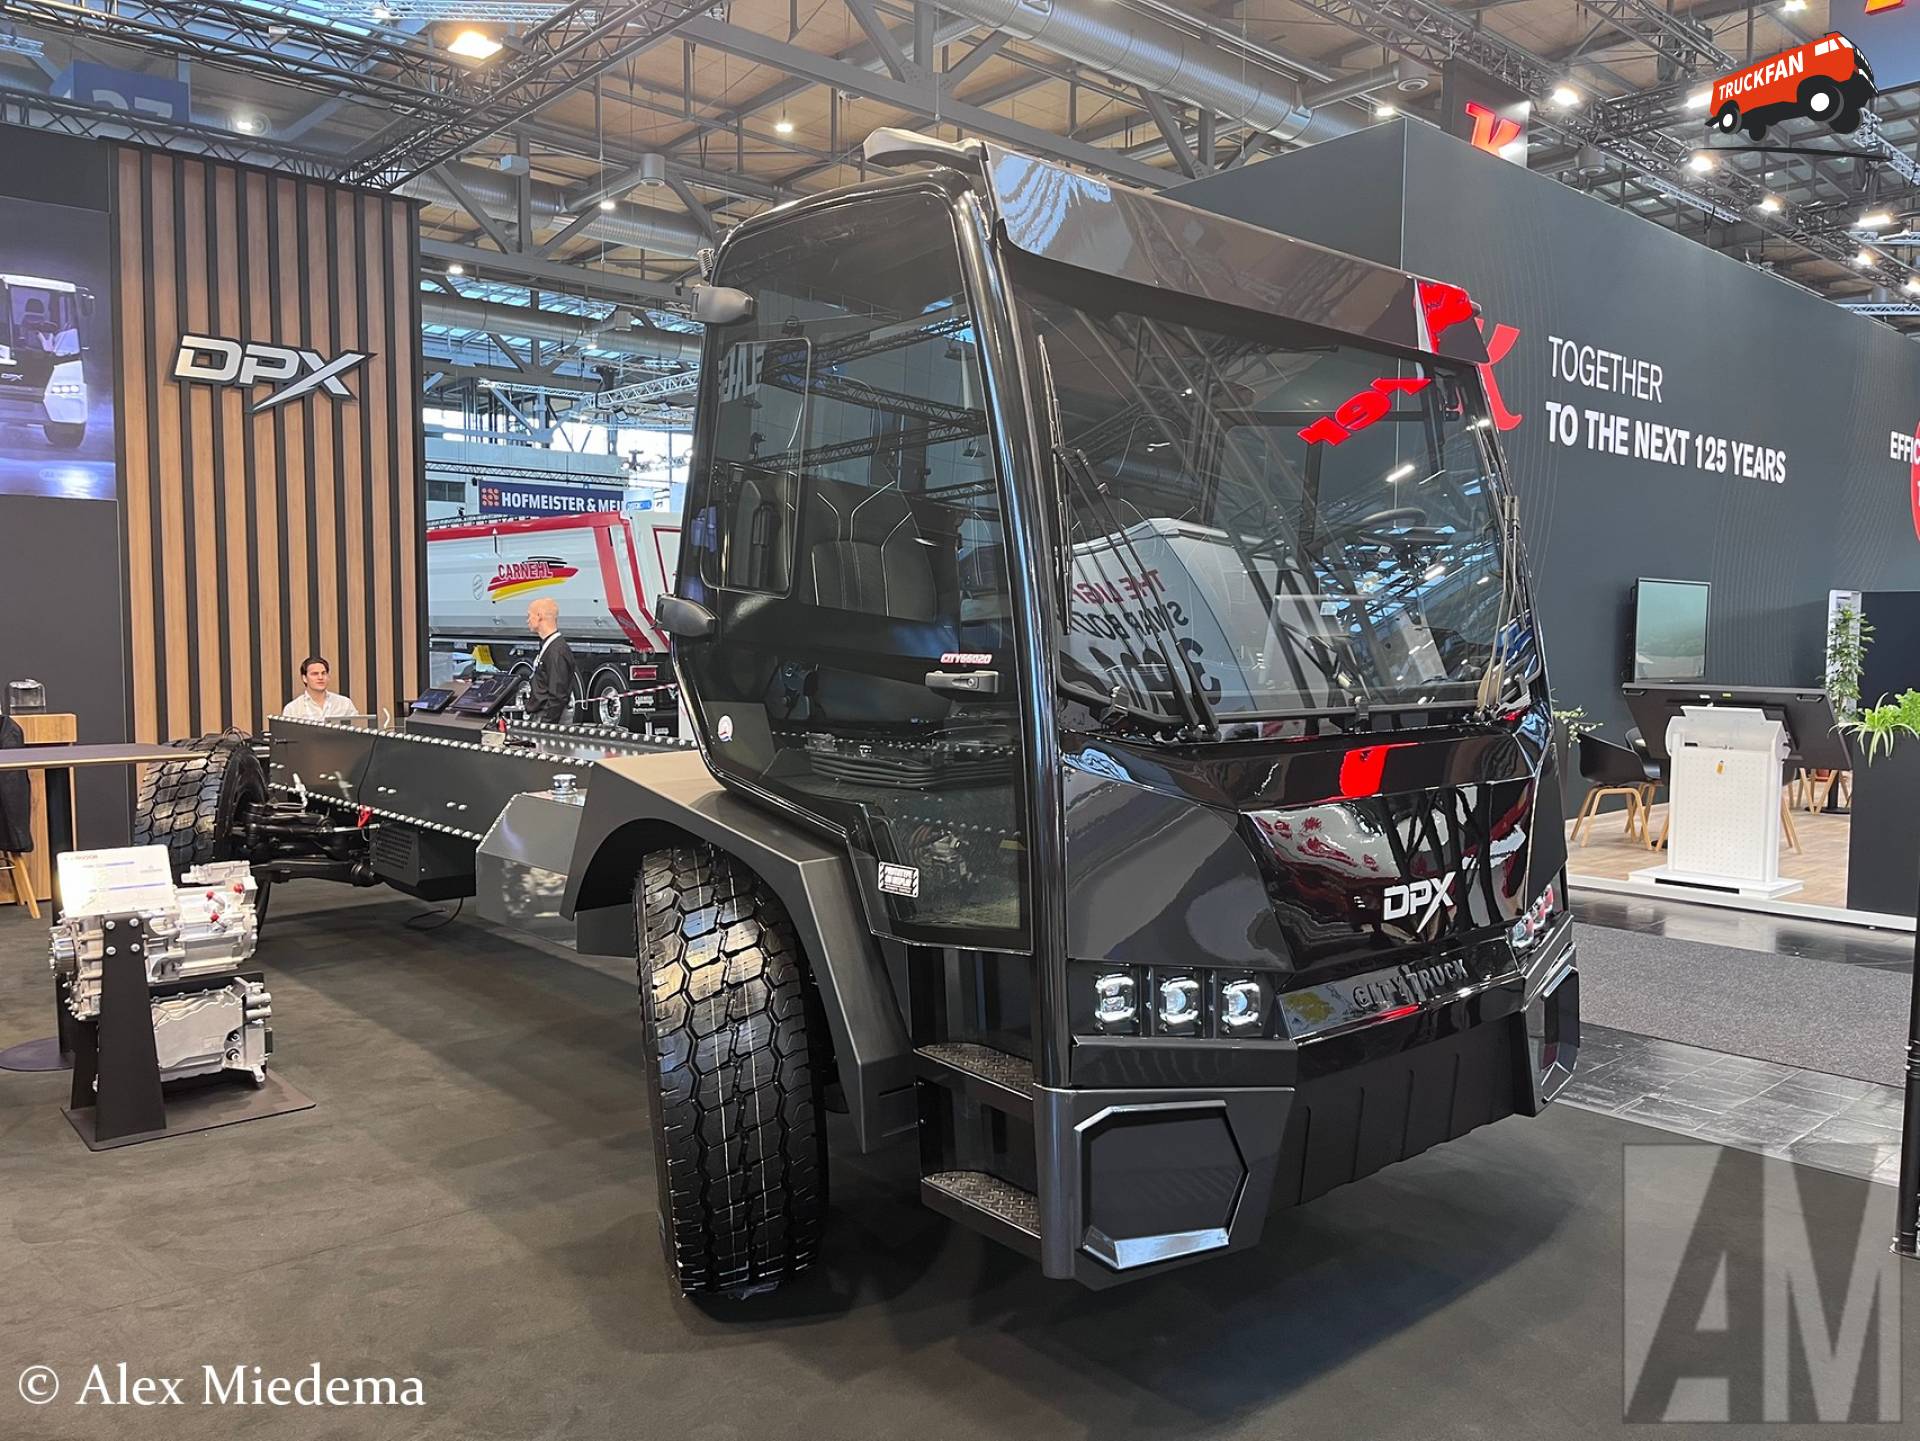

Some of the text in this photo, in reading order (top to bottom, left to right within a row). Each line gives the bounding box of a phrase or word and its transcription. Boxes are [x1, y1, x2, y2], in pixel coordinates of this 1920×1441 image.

[173, 334, 374, 413] DPX
[1548, 335, 1663, 403] TOGETHER
[1546, 401, 1787, 484] TO THE NEXT 125 YEARS
[501, 492, 585, 511] HOFMEISTER
[586, 498, 597, 512] &
[497, 561, 553, 579] CARNEHL
[1383, 871, 1457, 933] DPX
